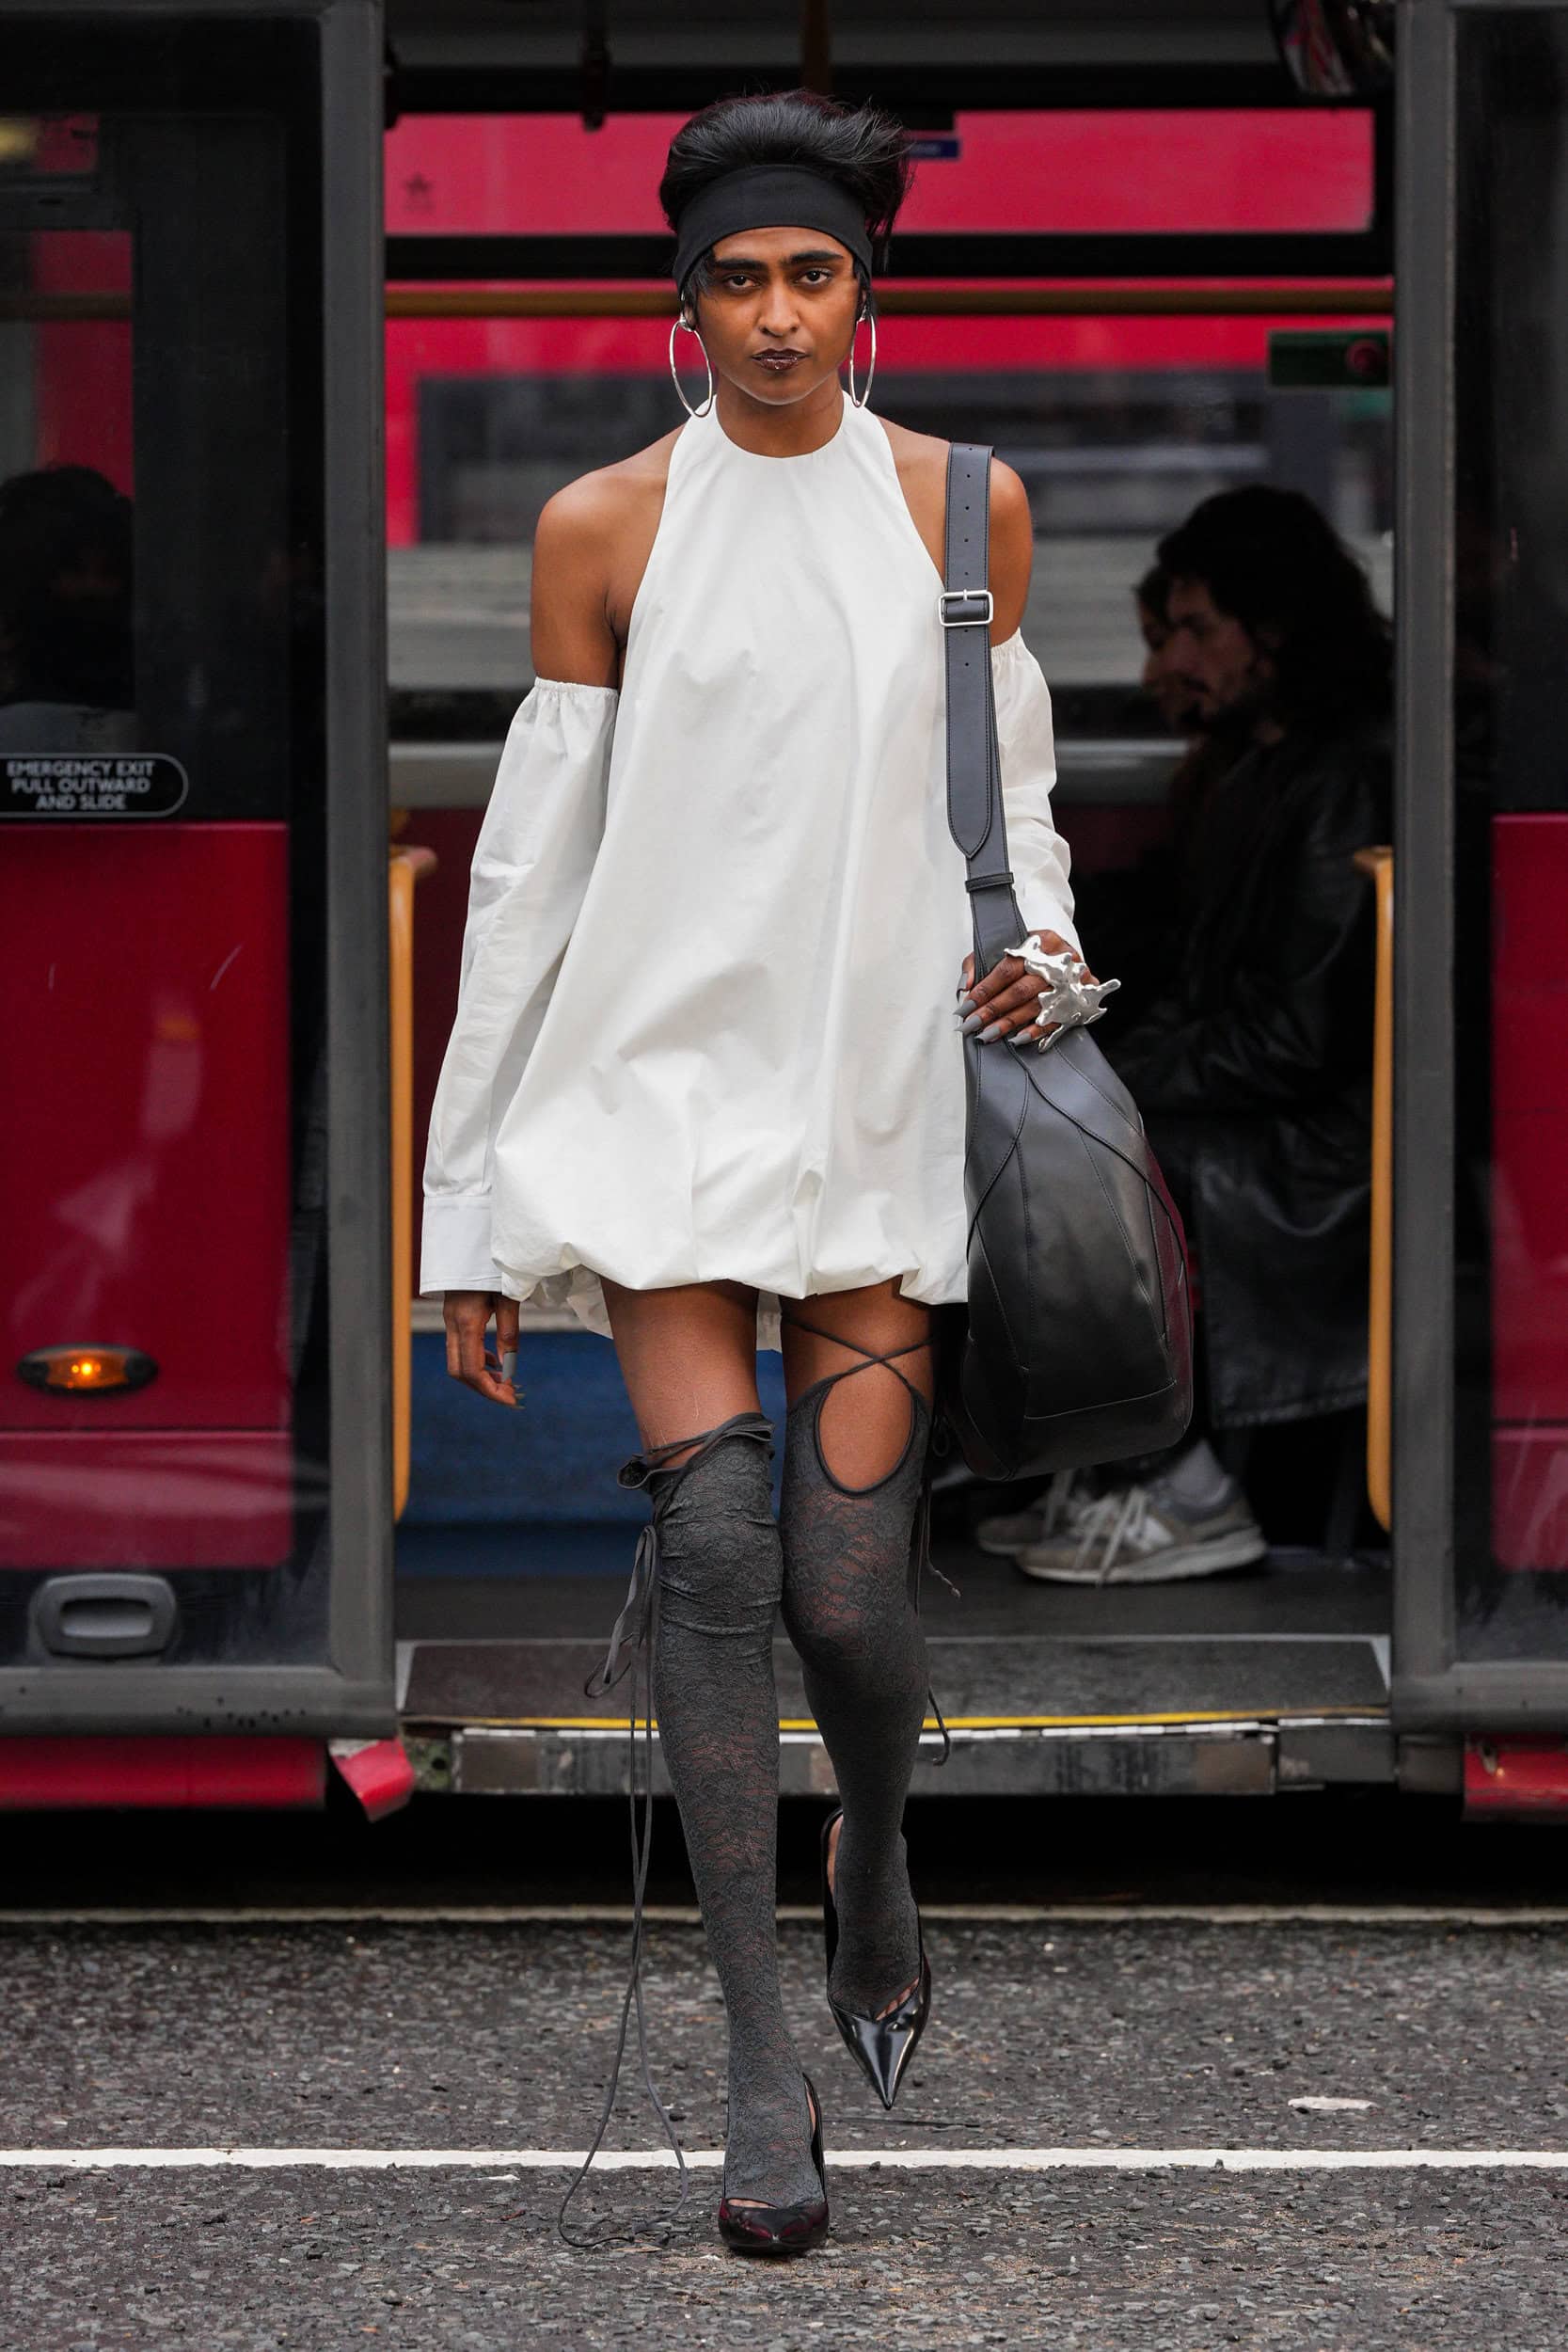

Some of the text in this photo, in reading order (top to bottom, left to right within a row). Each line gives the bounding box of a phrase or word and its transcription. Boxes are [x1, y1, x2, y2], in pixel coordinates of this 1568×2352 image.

[8, 760, 154, 776] EMERGENCY EXIT
[12, 777, 150, 793] PULL OUTWARD
[36, 794, 126, 810] AND SLIDE
